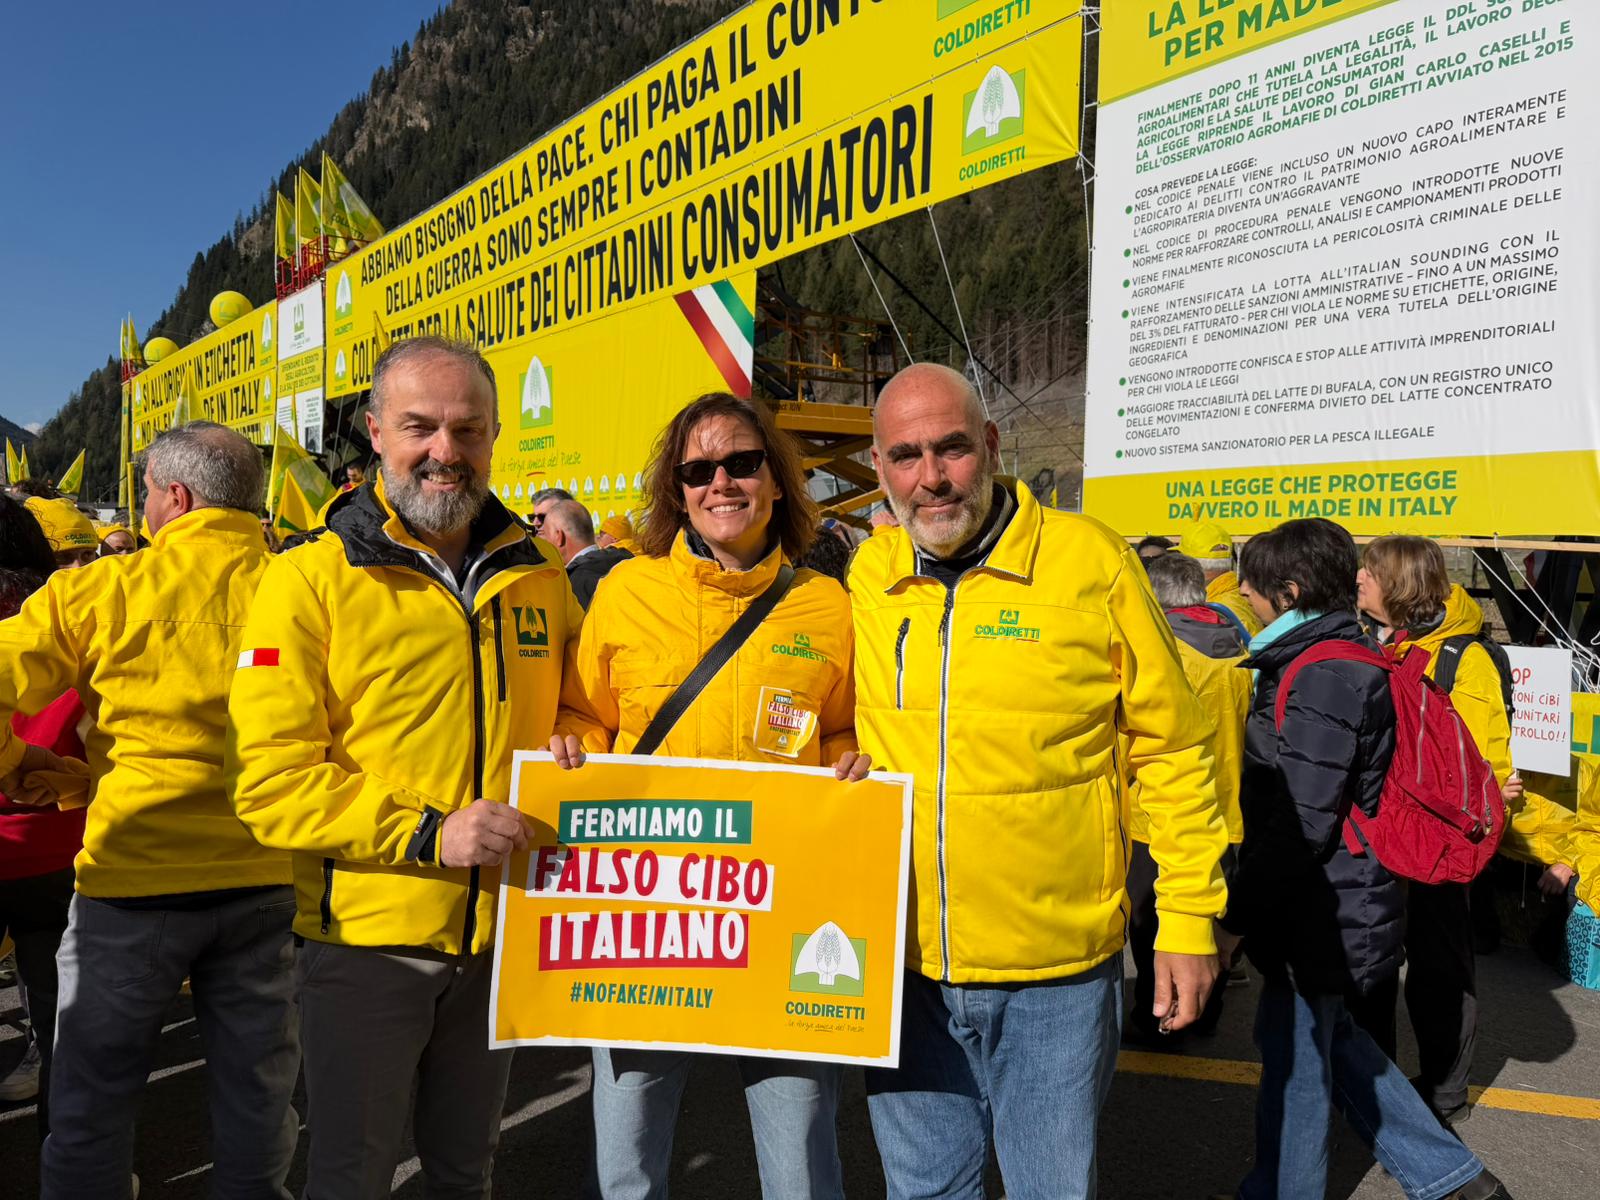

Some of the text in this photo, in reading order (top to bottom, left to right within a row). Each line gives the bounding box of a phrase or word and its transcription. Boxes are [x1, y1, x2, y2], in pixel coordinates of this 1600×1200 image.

[933, 0, 1031, 58] COLDIRETTI
[1148, 0, 1186, 38] LA
[1137, 1, 1477, 122] FINALMENTE DOPO 11 ANNI DIVENTA LEGGE IL DDL
[1164, 20, 1224, 67] PER
[1137, 0, 1565, 134] AGROALIMENTARI CHE TUTELA LA LEGALITÀ, IL LAVORO DE
[1135, 36, 1574, 173] DELL'OSSERVATORIO AGROMAFIE DI COLDIRETTI AVVIATO NEL 2015
[1136, 19, 1571, 161] LA LEGGE RIPRENDE IL LAVORO DI GIAN CARLO CASELLI E
[1136, 55, 1404, 148] AGRICOLTORI E LA SALUTE DEI CONSUMATORI
[361, 232, 413, 287] ABBIAMO
[415, 195, 476, 259] BISOGNO
[480, 161, 533, 224] DELLA
[537, 126, 594, 192] PACE.
[601, 92, 638, 154] CHI
[648, 46, 720, 130] PAGA
[730, 24, 756, 84] IL
[767, 0, 884, 60] CON
[959, 146, 1025, 181] COLDIRETTI
[1134, 89, 1566, 212] NEL CODICE PENALE VIENE INCLUSO UN NUOVO CAPO INTERAMENTE
[386, 67, 801, 316] DELLA GUERRA SONO SEMPRE I CONTADINI
[1134, 157, 1257, 199] COSA PREVEDE LA LEGGE:
[466, 276, 525, 349] SALUTE
[530, 262, 558, 333] DEI
[564, 211, 673, 321] CITTADINI
[682, 93, 933, 280] CONSUMATORI
[1133, 172, 1360, 237] L'AGROPIRATERIA DIVENTA UN'AGGRAVANTE
[1132, 188, 1562, 286] VIENE FINALMENTE RICONOSCIUTA LA PERICOLOSITÀ CRIMINALE DELLE
[1131, 279, 1185, 299] AGROMAFIE
[1129, 279, 1557, 354] INGREDIENTI E DENOMINAZIONI PER UNA VERA TUTELA DELL'ORIGINE
[151, 360, 191, 410] ALL'ORIGI
[194, 354, 203, 391] IN
[205, 331, 256, 387] ETICHETTA
[1128, 350, 1188, 367] GEOGRAFICA
[216, 391, 228, 424] IN
[230, 378, 261, 420] ITALY
[519, 434, 555, 452] COLDIRETTI
[1124, 425, 1435, 458] NUOVO SISTEMA SANZIONATORIO PER LA PESCA ILLEGALE
[1125, 426, 1181, 441] CONGELATO
[1166, 470, 1457, 498] UNA LEGGE CHE PROTEGGE
[1265, 500, 1282, 518] IL
[1288, 498, 1351, 518] MADE
[1358, 498, 1381, 517] IN
[1388, 495, 1458, 517] ITALY
[518, 649, 550, 659] COLDIRETTI
[771, 643, 828, 664] COLDIRETTI
[975, 624, 1041, 640] COLDIRETTI
[1511, 667, 1532, 685] OP
[768, 701, 790, 715] FALSO
[1512, 725, 1567, 742] TROLLO!!
[569, 806, 738, 838] FERMIAMO IL
[534, 845, 769, 906] FALSO CIBO
[548, 909, 746, 962] ITALIANO
[785, 1001, 865, 1020] COLDIRETTI
